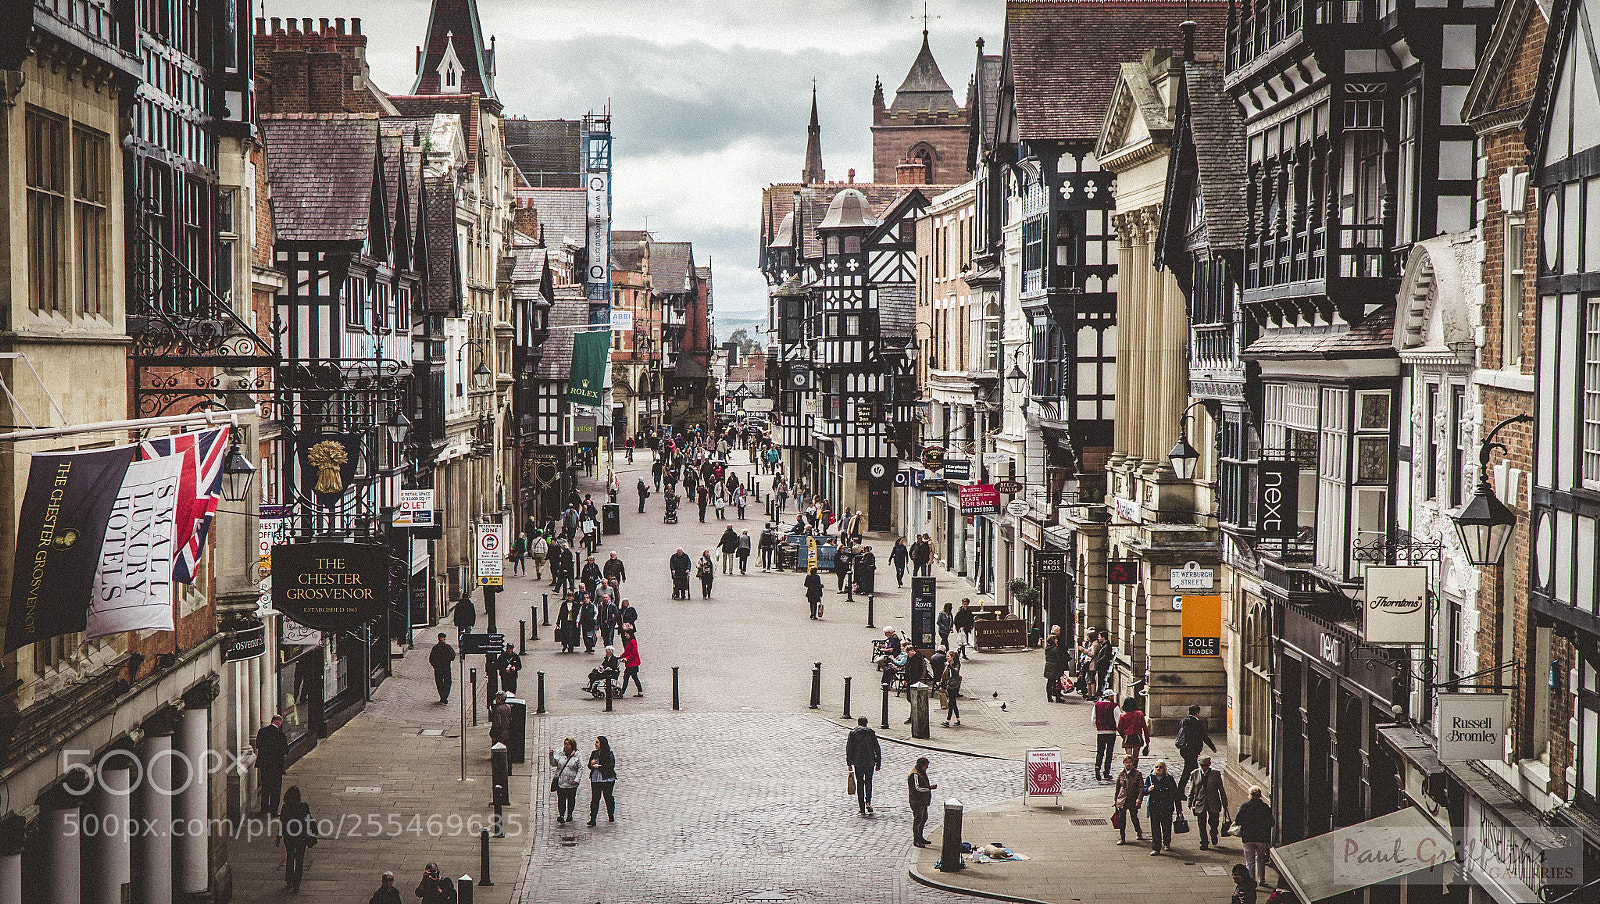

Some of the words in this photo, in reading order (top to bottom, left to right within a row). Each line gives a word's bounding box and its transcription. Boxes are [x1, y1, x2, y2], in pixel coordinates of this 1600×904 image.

[570, 387, 599, 399] ROLEX
[54, 461, 72, 486] THE
[402, 501, 410, 509] O
[411, 501, 427, 509] LET
[1263, 471, 1282, 531] next
[40, 489, 64, 547] CHESTER
[100, 494, 131, 602] HOTELS
[125, 491, 154, 605] LUXURY
[149, 484, 175, 597] SMALL
[315, 558, 346, 570] THE
[298, 573, 363, 585] CHESTER
[24, 550, 48, 633] GROSVENOR
[286, 588, 374, 600] GROSVENOR
[1369, 595, 1420, 609] Thorntons
[1187, 638, 1214, 648] SOLE
[1319, 632, 1341, 666] next
[1452, 716, 1492, 729] Russell
[1452, 729, 1498, 745] Bromley
